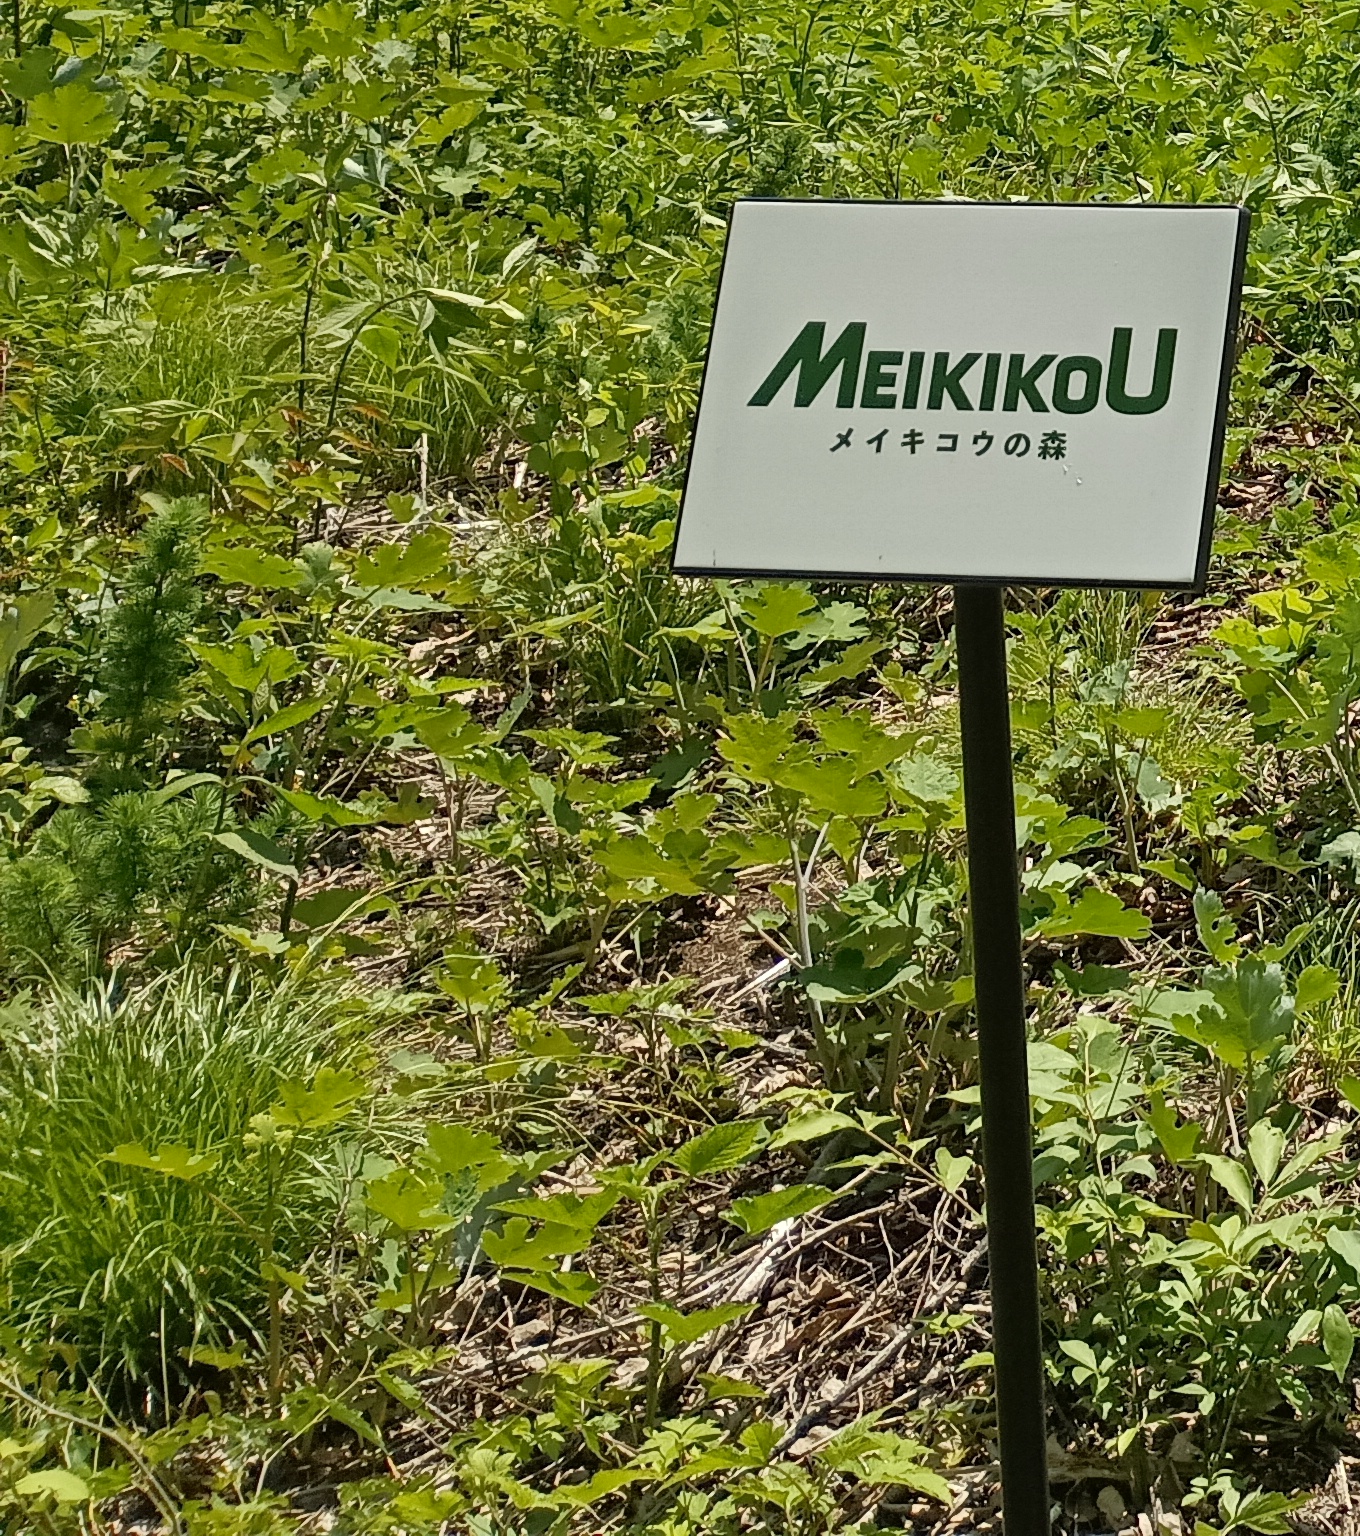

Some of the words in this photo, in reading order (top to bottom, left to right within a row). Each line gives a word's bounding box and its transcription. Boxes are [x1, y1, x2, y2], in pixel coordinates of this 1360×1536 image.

[746, 320, 1179, 416] MEIKIKOU
[829, 427, 1068, 461] メイキコウの森
